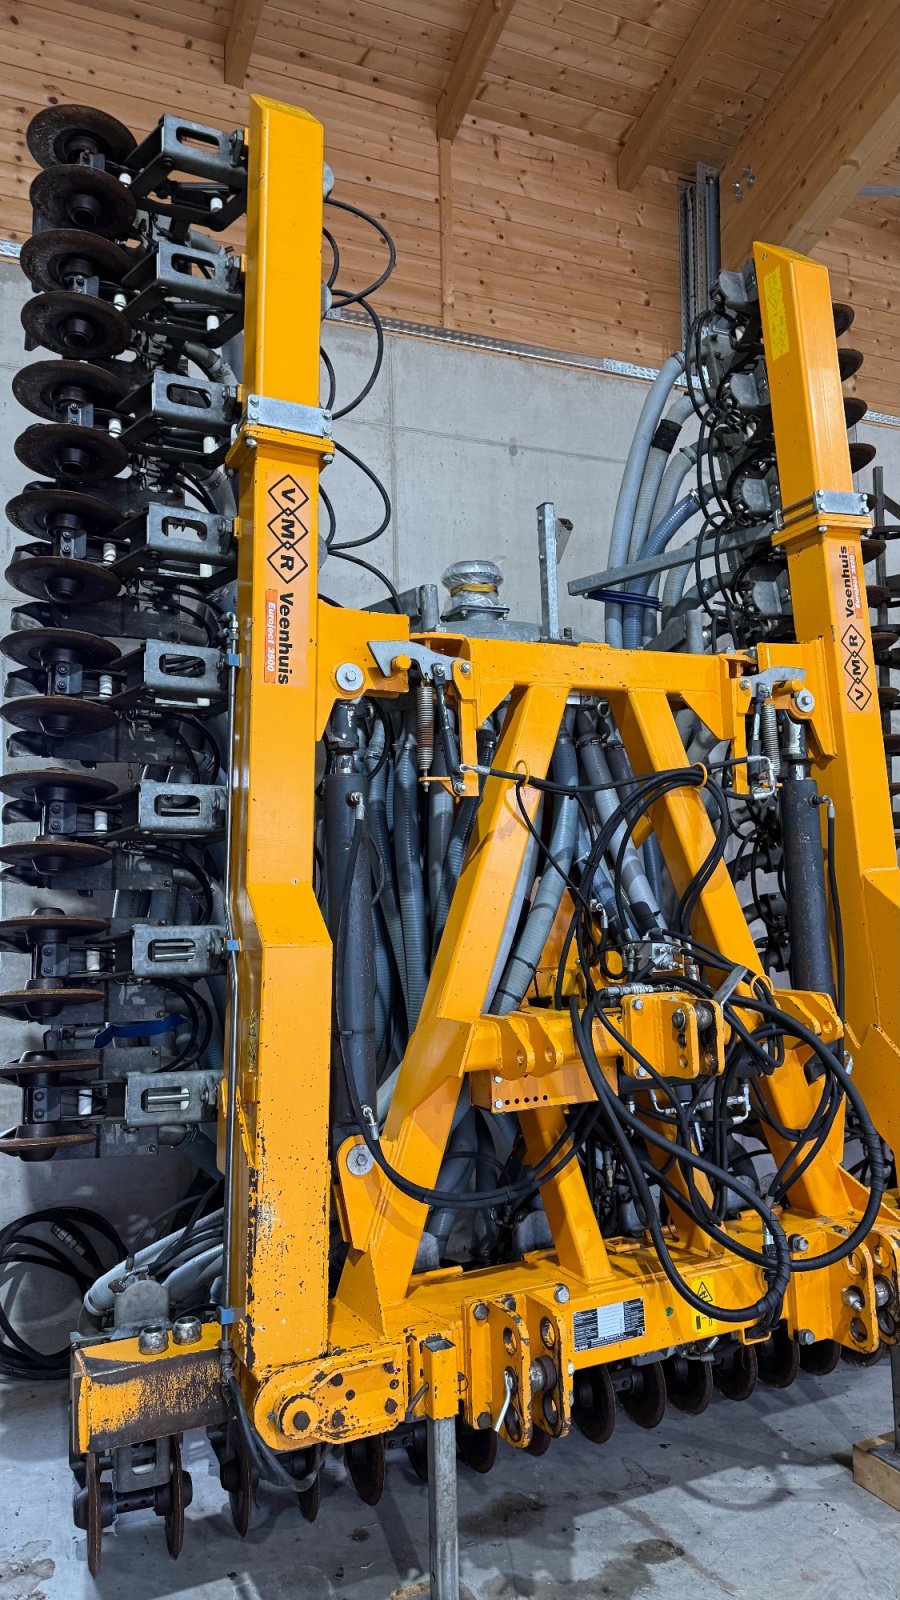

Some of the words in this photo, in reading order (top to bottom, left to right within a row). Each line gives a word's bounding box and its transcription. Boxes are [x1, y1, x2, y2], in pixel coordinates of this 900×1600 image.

[280, 487, 296, 571] VMR
[839, 545, 855, 618] Veenhuis
[267, 645, 276, 673] 3500
[278, 592, 294, 685] Veenhuis
[849, 634, 865, 701] VMR
